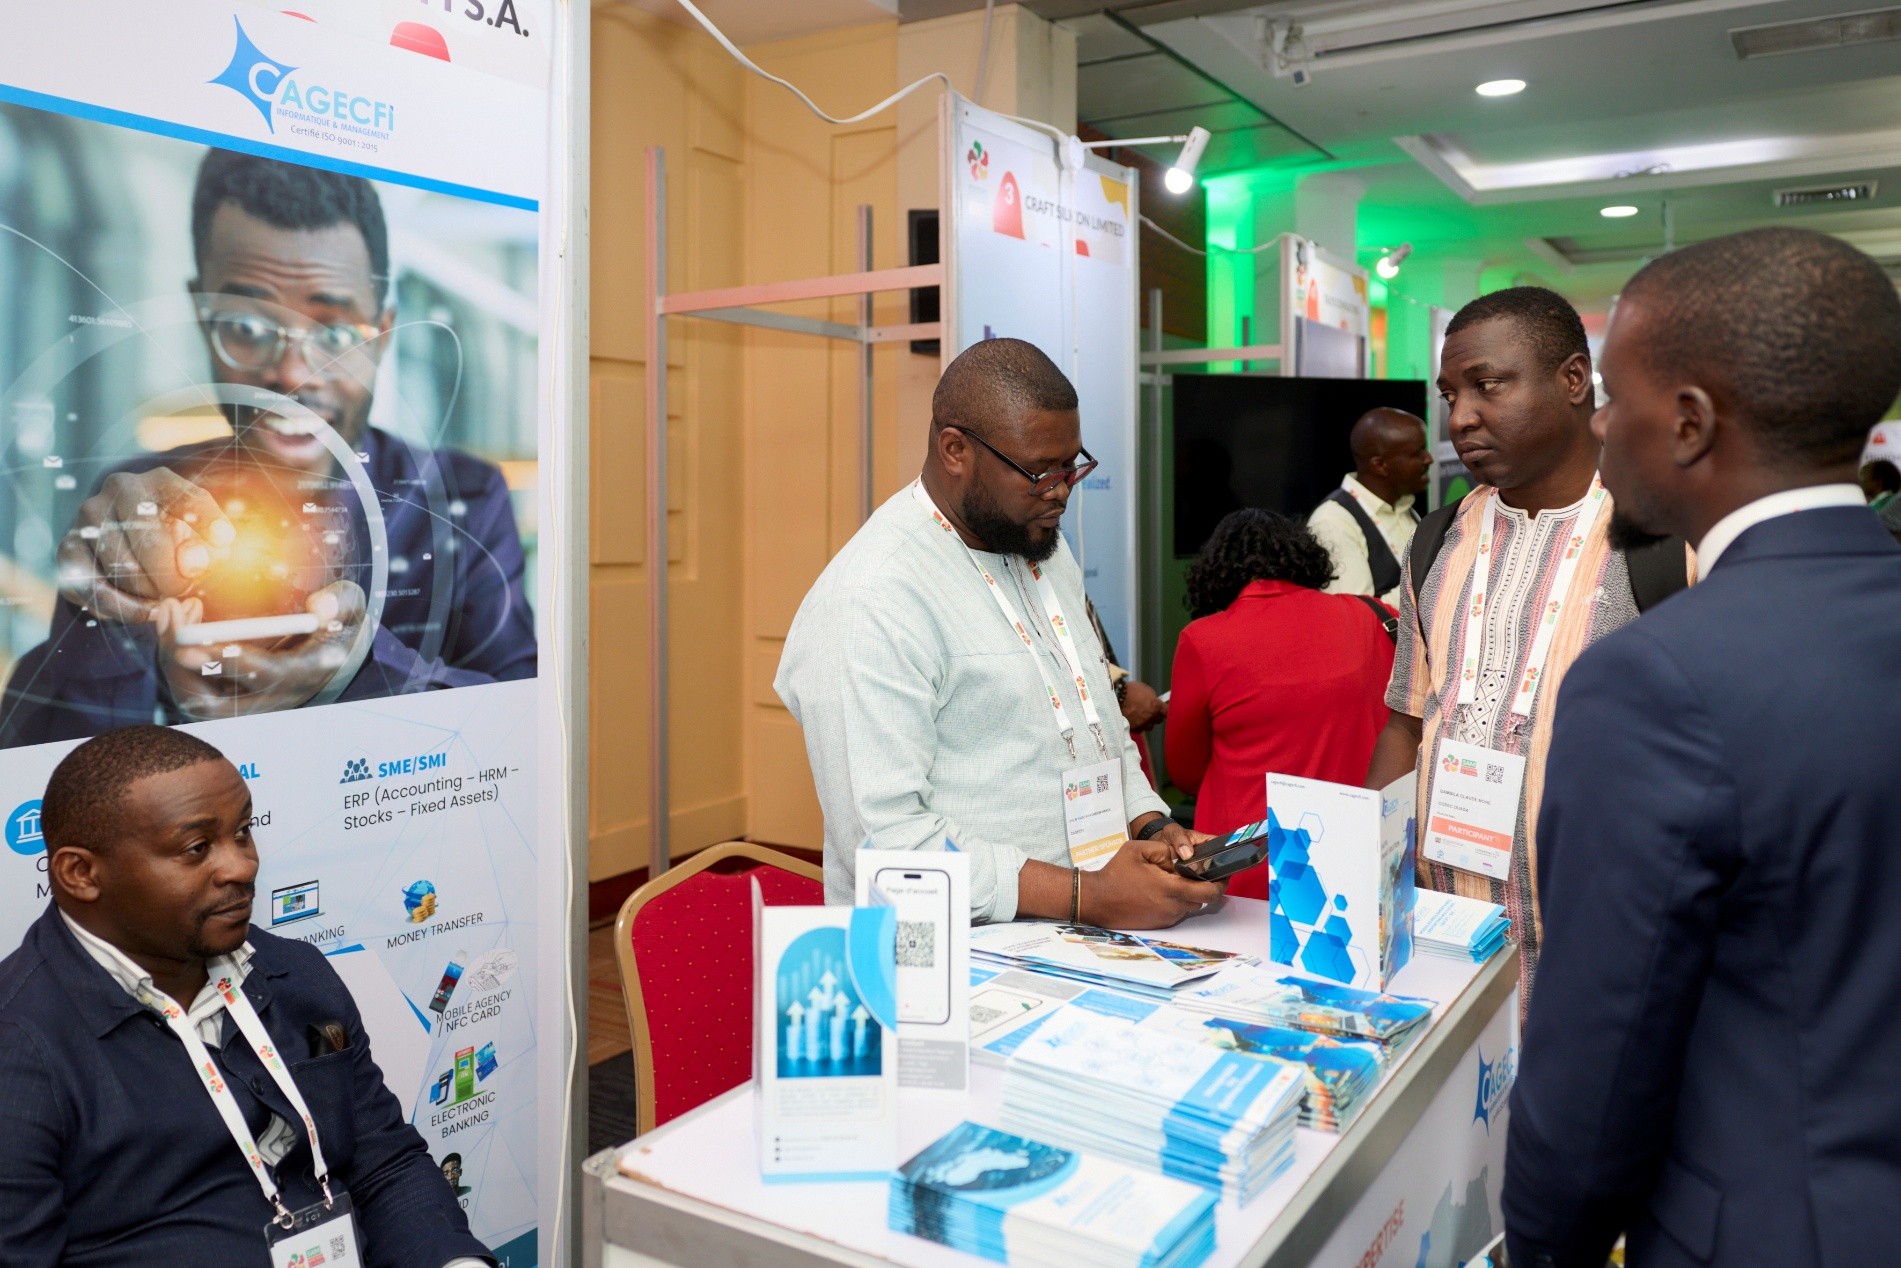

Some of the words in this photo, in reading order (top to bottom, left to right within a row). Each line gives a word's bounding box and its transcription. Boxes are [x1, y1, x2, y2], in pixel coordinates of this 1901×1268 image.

[276, 107, 331, 128] INFORMATIQUE
[332, 121, 338, 129] &
[340, 123, 390, 141] MANAGEMENT
[290, 124, 320, 139] Certifié
[321, 132, 336, 142] ISO
[361, 142, 378, 153] 2015
[1004, 182, 1014, 205] 3
[1025, 195, 1055, 216] CRAFT
[1057, 205, 1090, 226] SILION
[239, 763, 261, 780] AL
[378, 752, 447, 779] SME/SMI
[344, 792, 370, 810] ERP
[374, 777, 463, 806] (Accounting
[479, 766, 508, 784] HRM
[344, 809, 393, 830] Stocks
[410, 797, 447, 817] Fixed
[450, 783, 499, 808] Assets)
[1448, 825, 1495, 843] PARTICIPANT
[387, 927, 429, 949] MONEY
[430, 912, 484, 937] TRANSFER
[436, 1002, 473, 1024] MOBILE
[475, 989, 512, 1011] AGENCY
[446, 1016, 468, 1033] NFC
[470, 1005, 501, 1024] CARD
[431, 1091, 496, 1127] ELECTRONIC
[441, 1110, 490, 1139] BANKING
